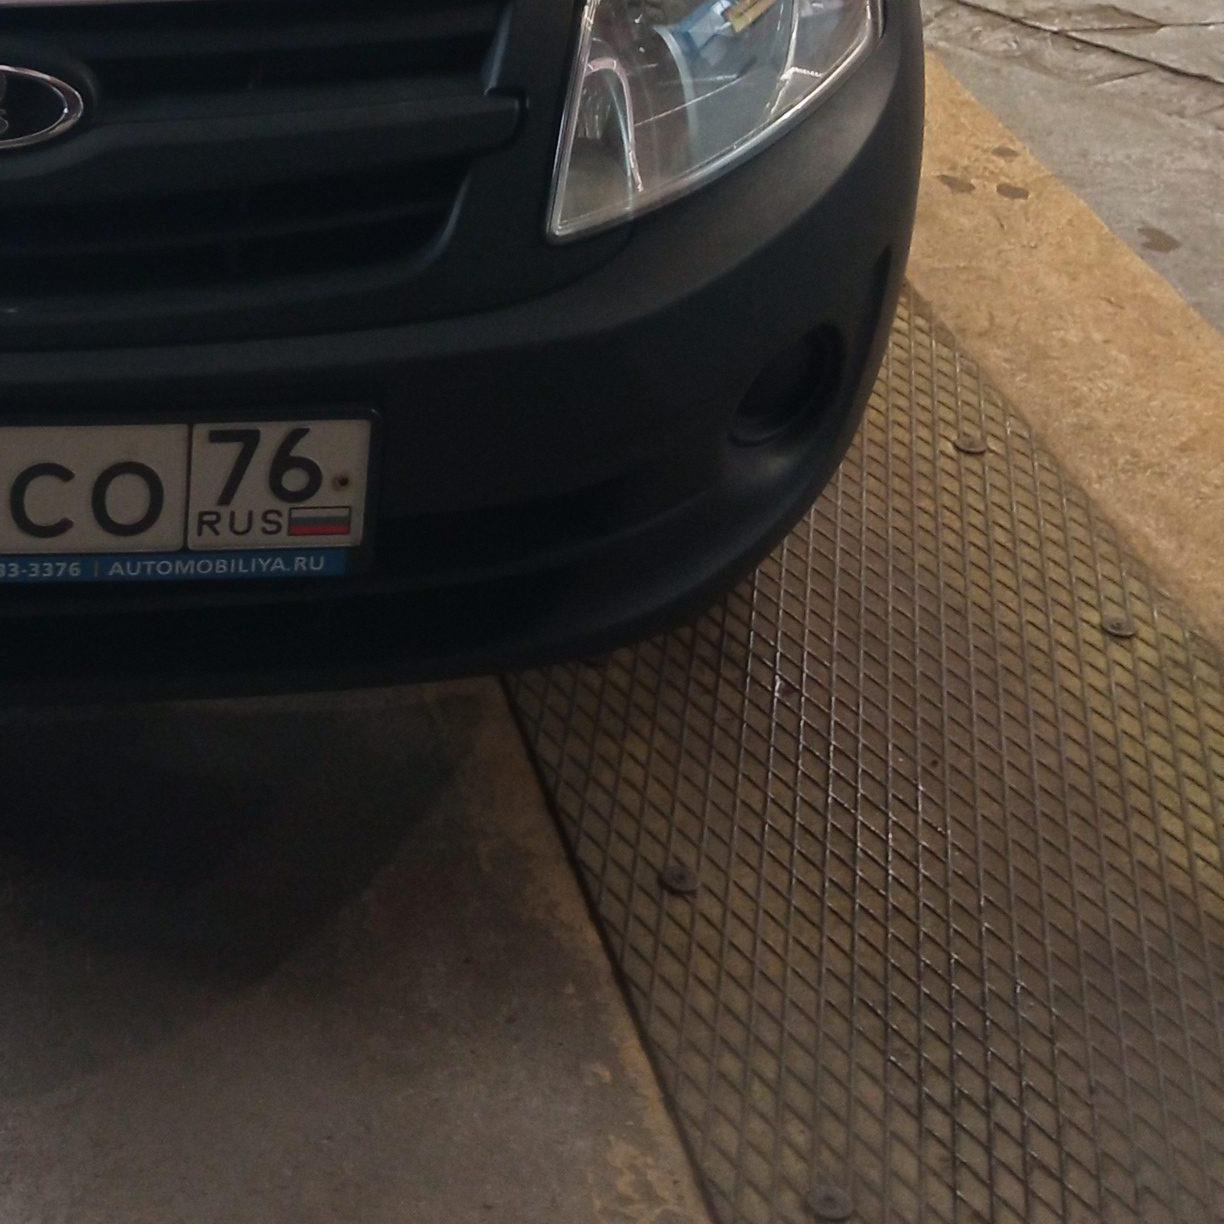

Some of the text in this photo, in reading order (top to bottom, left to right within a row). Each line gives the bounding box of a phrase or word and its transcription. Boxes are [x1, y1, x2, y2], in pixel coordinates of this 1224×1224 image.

[208, 427, 324, 506] 76
[196, 508, 283, 537] RUS
[108, 555, 326, 577] AUTOMOBILIYA.RU
